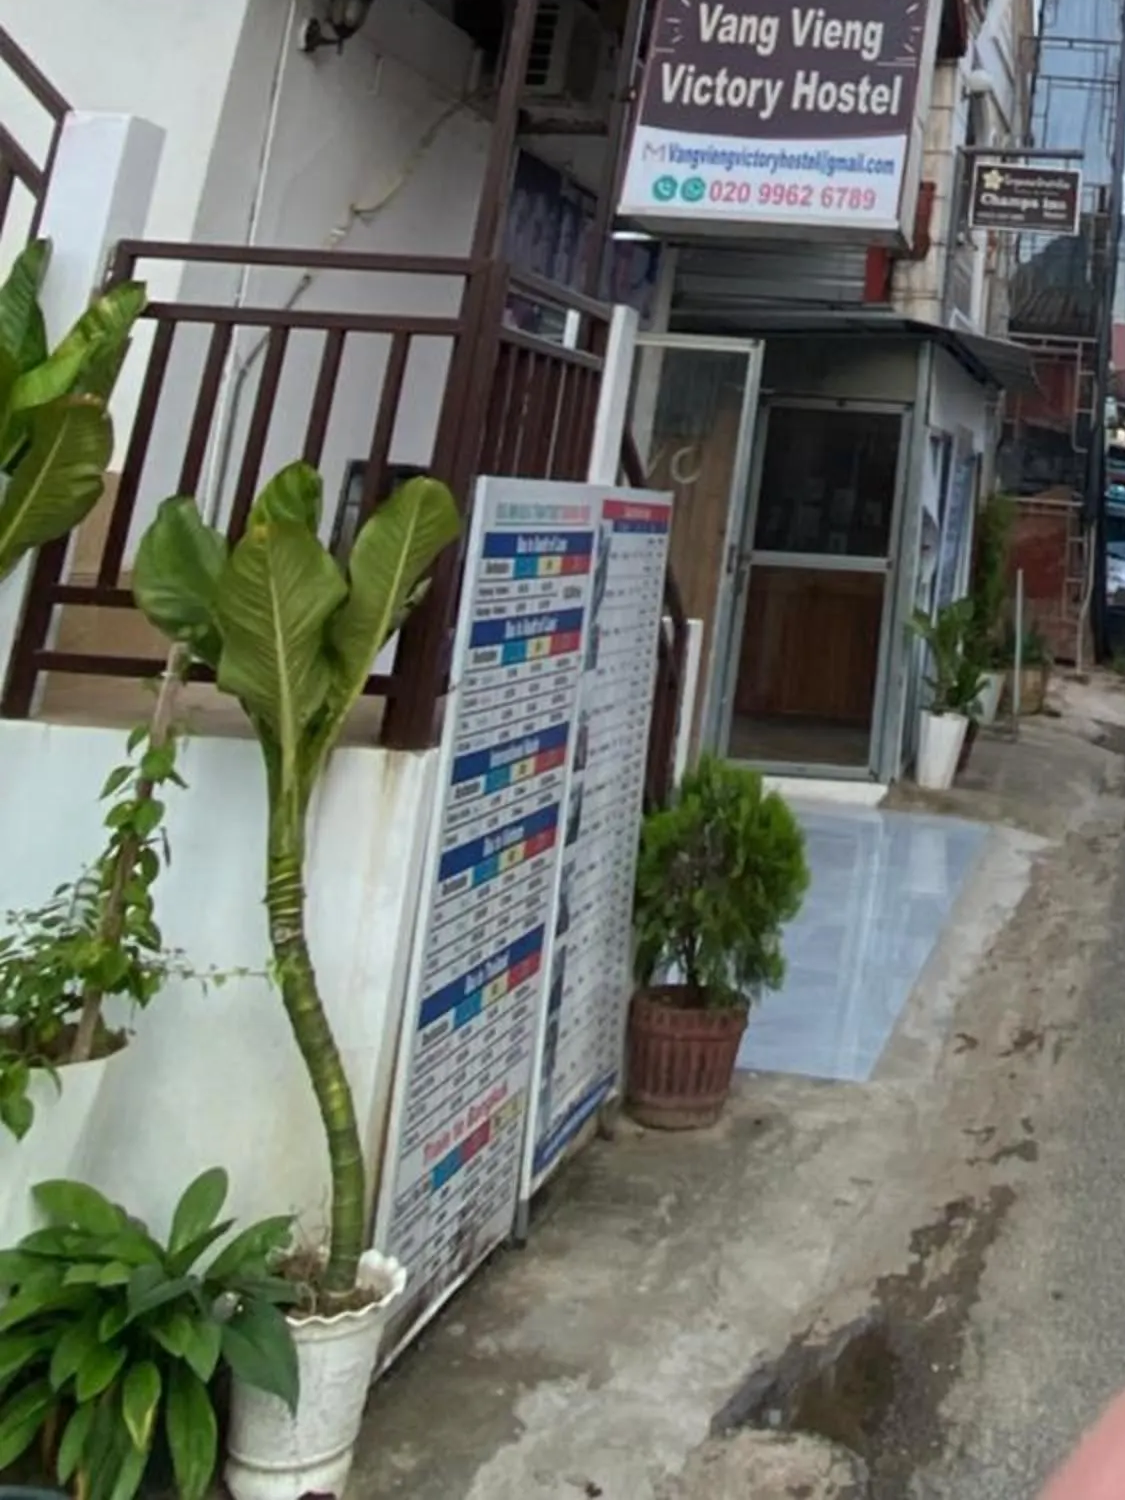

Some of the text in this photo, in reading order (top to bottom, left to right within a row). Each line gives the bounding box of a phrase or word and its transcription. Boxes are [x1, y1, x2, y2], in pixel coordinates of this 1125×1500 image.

[699, 2, 884, 61] Vang Vieng
[661, 62, 903, 120] Victory Hostel
[709, 180, 877, 211] 020 9962 6789
